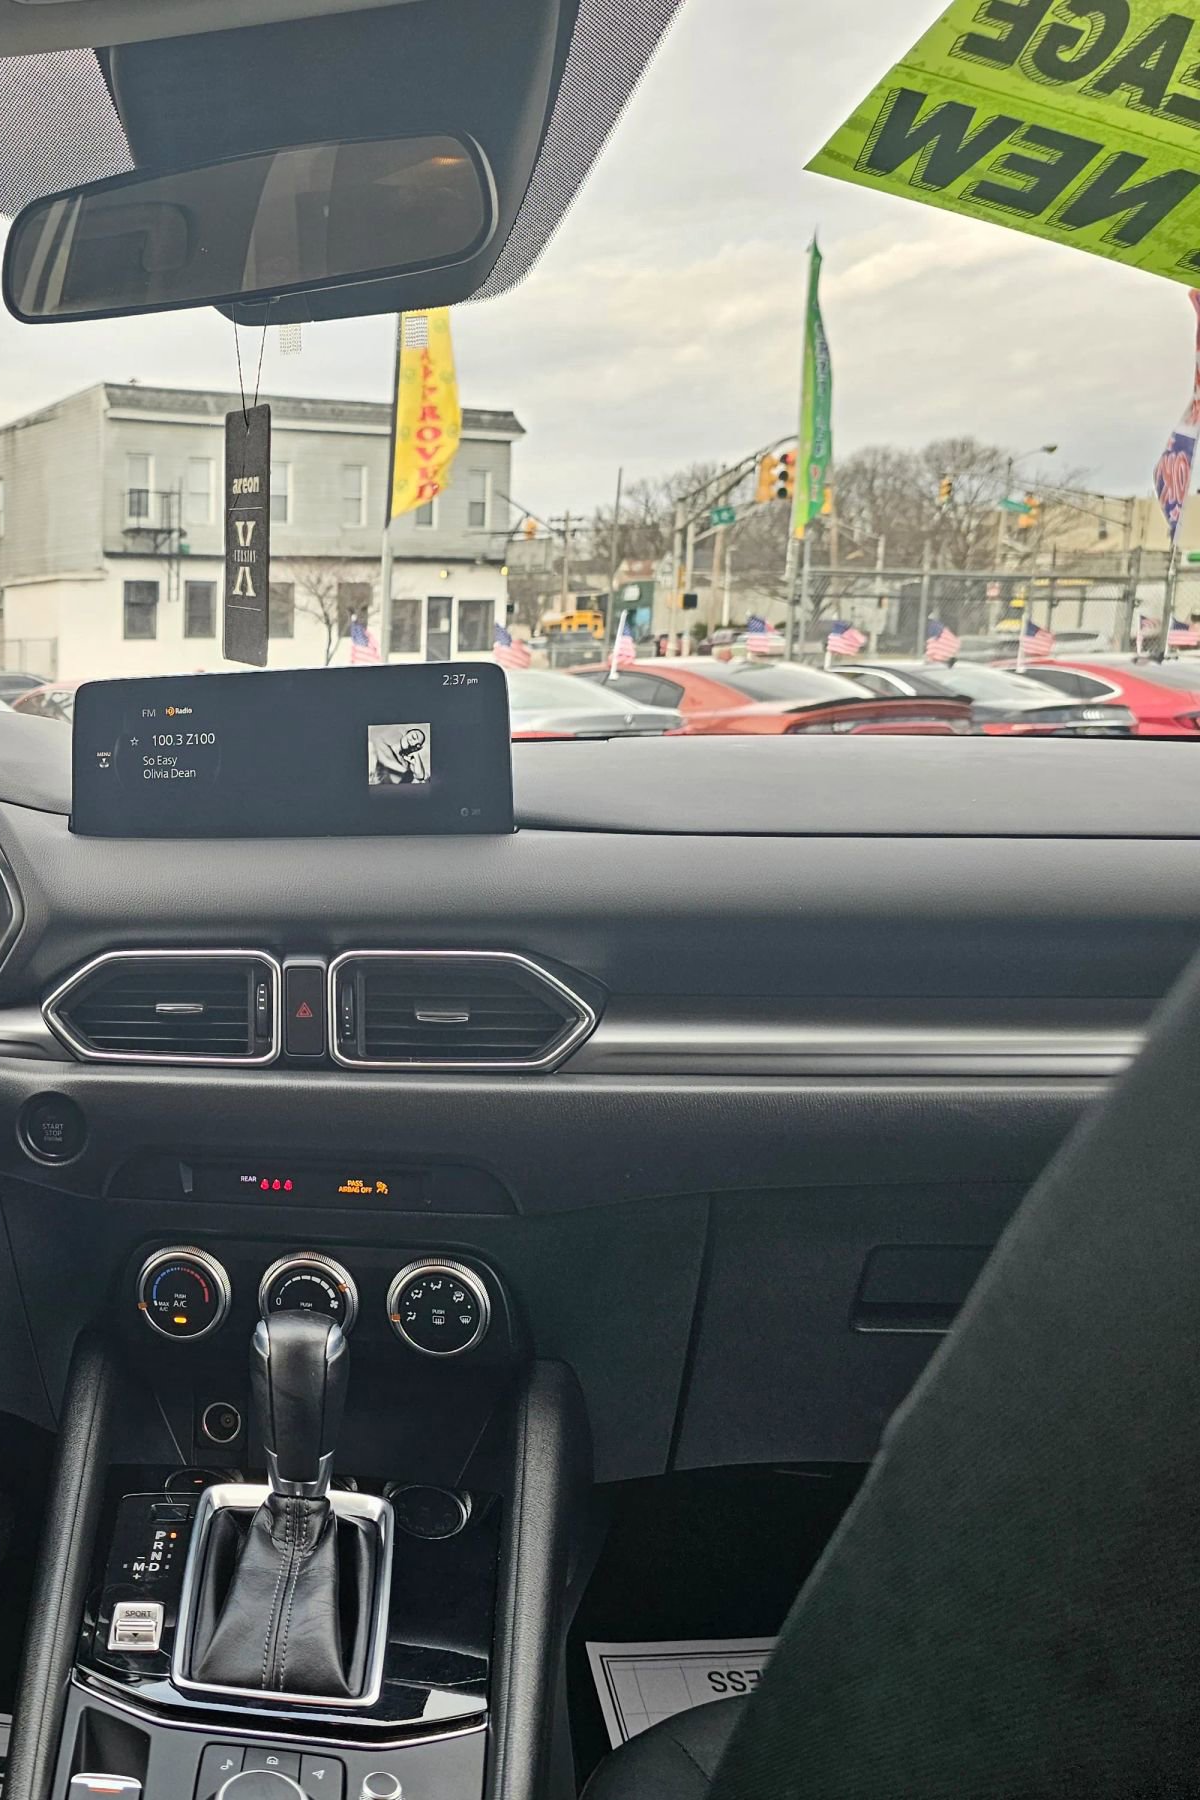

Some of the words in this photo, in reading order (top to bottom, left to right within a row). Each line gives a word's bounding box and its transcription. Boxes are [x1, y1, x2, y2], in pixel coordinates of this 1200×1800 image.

[232, 476, 260, 495] areon
[442, 674, 466, 686] 2:37
[466, 677, 479, 686] pm
[142, 709, 156, 718] FM
[175, 707, 193, 715] Radio
[152, 734, 183, 746] 100.3
[186, 733, 216, 745] Z100
[143, 756, 155, 766] So
[157, 756, 178, 767] Easy
[143, 768, 169, 779] Olivia
[170, 768, 196, 778] Dean
[347, 1179, 363, 1187] PASS
[338, 1186, 360, 1194] AIRBAG
[173, 1300, 187, 1308] A/C
[275, 1297, 282, 1306] 0
[155, 1530, 167, 1540] P
[153, 1541, 164, 1550] R
[150, 1551, 162, 1561] N
